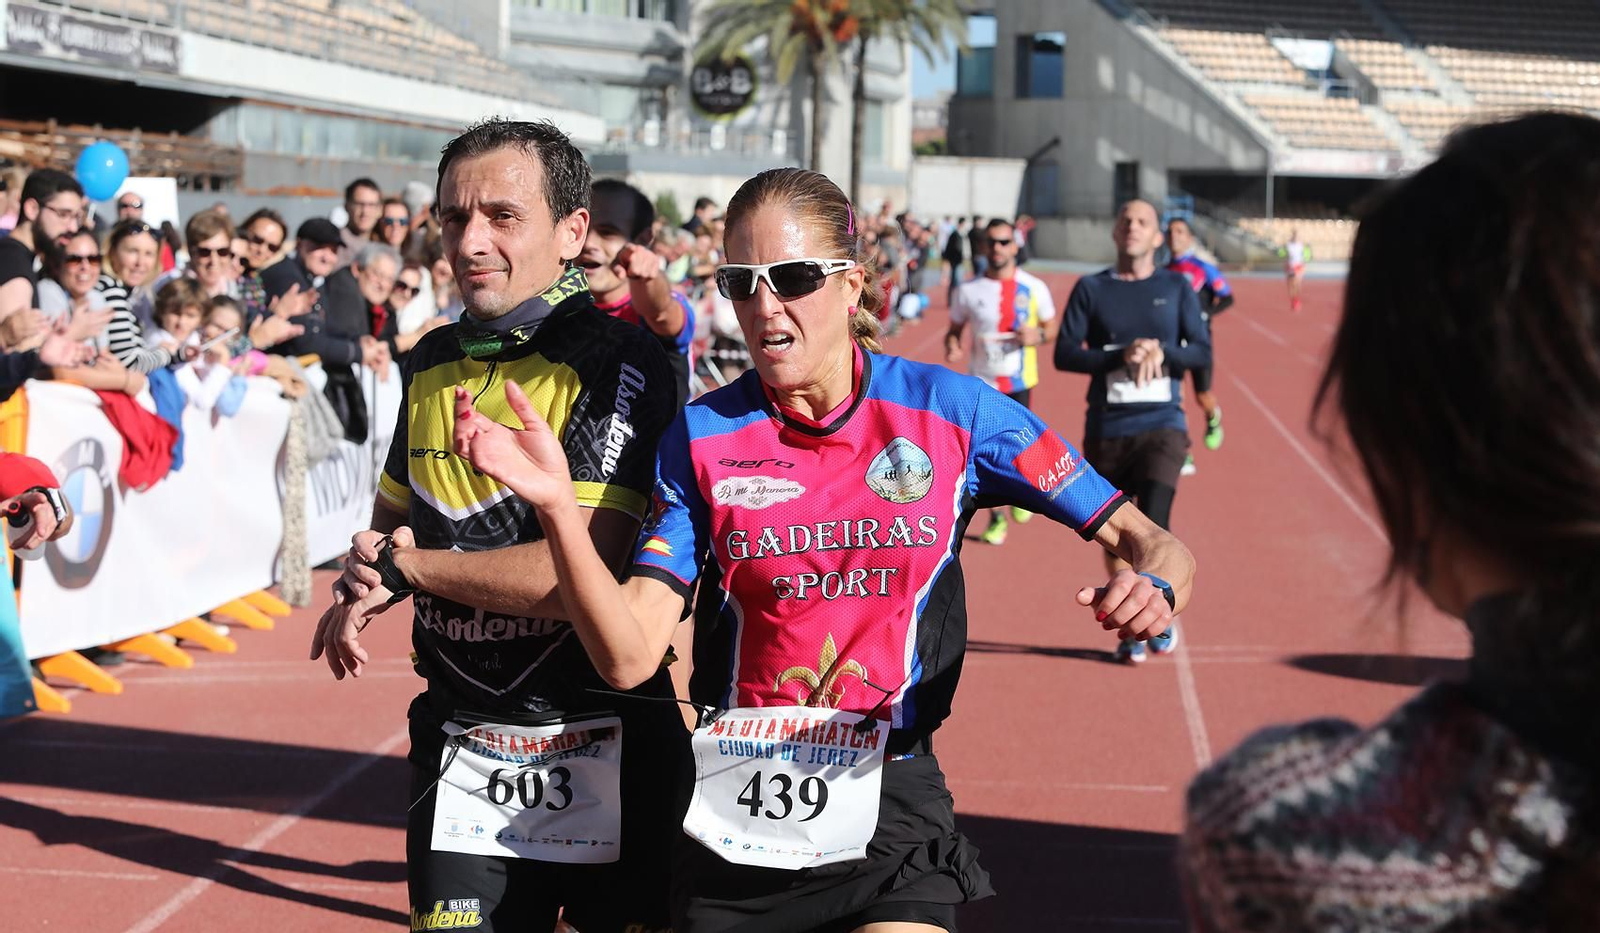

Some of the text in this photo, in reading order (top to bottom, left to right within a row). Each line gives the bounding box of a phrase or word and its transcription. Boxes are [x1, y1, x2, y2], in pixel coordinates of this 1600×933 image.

[718, 458, 796, 469] aero
[726, 515, 938, 562] GADEIRAS
[772, 567, 899, 600] SPORT
[718, 739, 859, 768] CIUDAD DE JEREZ
[487, 766, 573, 811] 603
[737, 770, 829, 822] 439
[450, 900, 479, 910] BIKE
